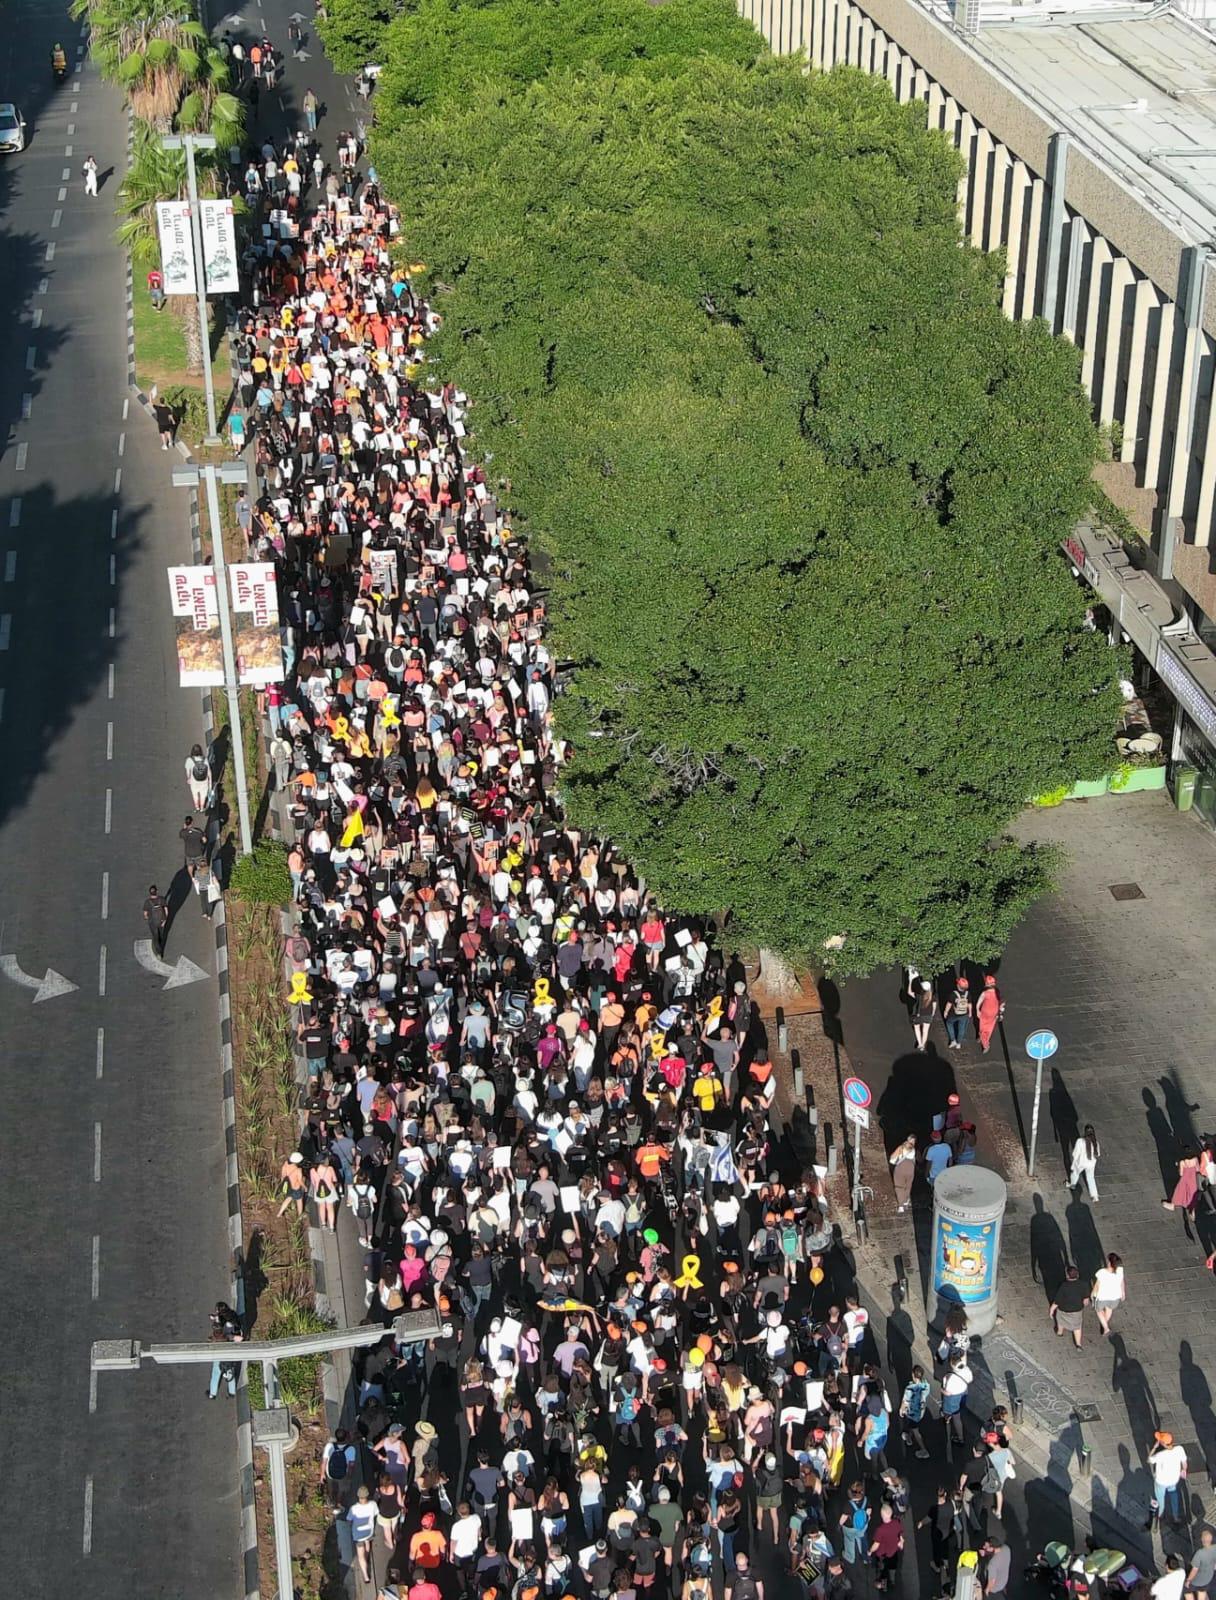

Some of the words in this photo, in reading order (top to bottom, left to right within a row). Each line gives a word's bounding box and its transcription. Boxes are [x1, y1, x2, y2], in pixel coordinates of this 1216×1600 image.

[162, 208, 171, 230] פיטר
[205, 206, 215, 229] פיטר
[175, 574, 191, 608] שיקוי
[236, 570, 252, 604] שיקוי
[192, 587, 209, 629] האהבה
[253, 584, 269, 625] האהבה
